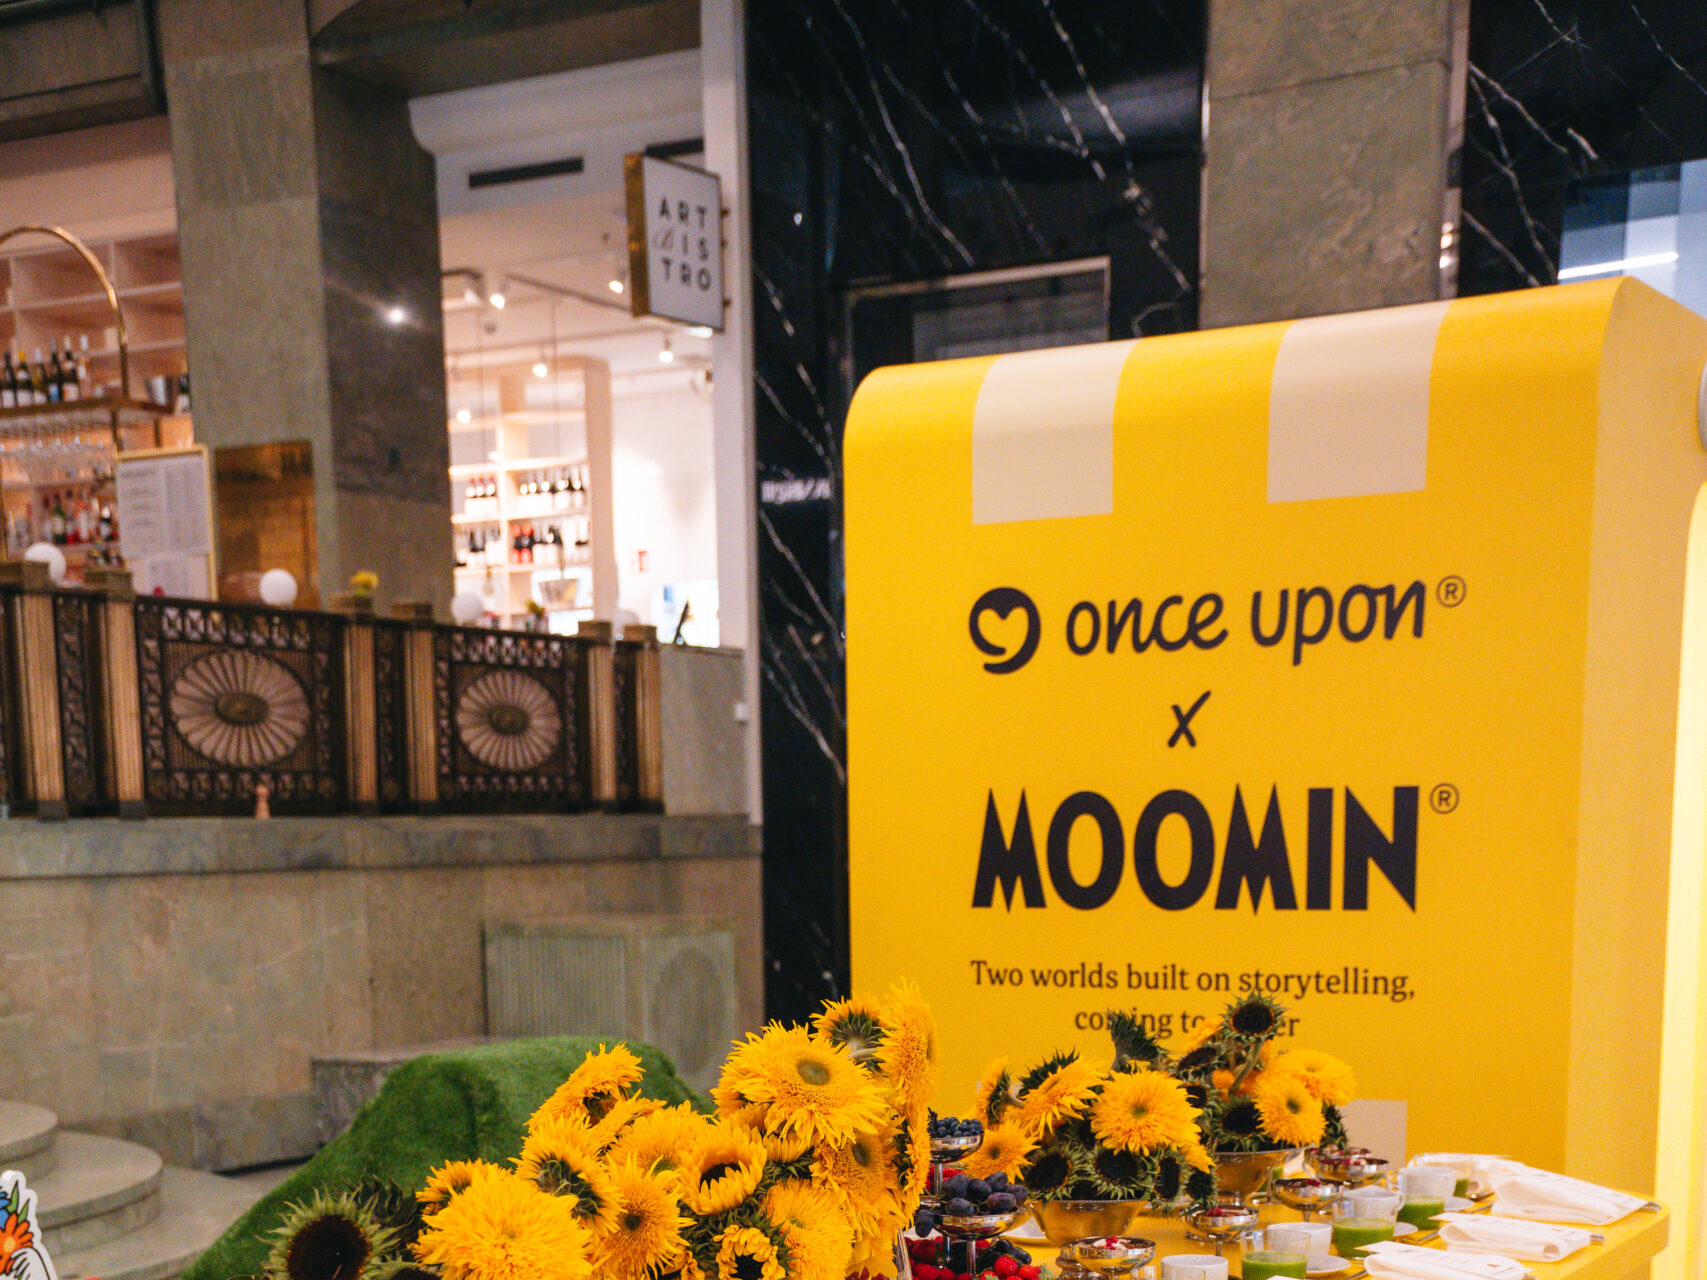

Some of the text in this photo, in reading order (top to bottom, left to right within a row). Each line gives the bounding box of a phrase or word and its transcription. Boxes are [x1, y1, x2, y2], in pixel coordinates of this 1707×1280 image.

[659, 196, 707, 231] ART
[662, 256, 712, 292] TRO
[1065, 592, 1229, 657] once
[970, 960, 1415, 1003] Two worlds built on storytelling,
